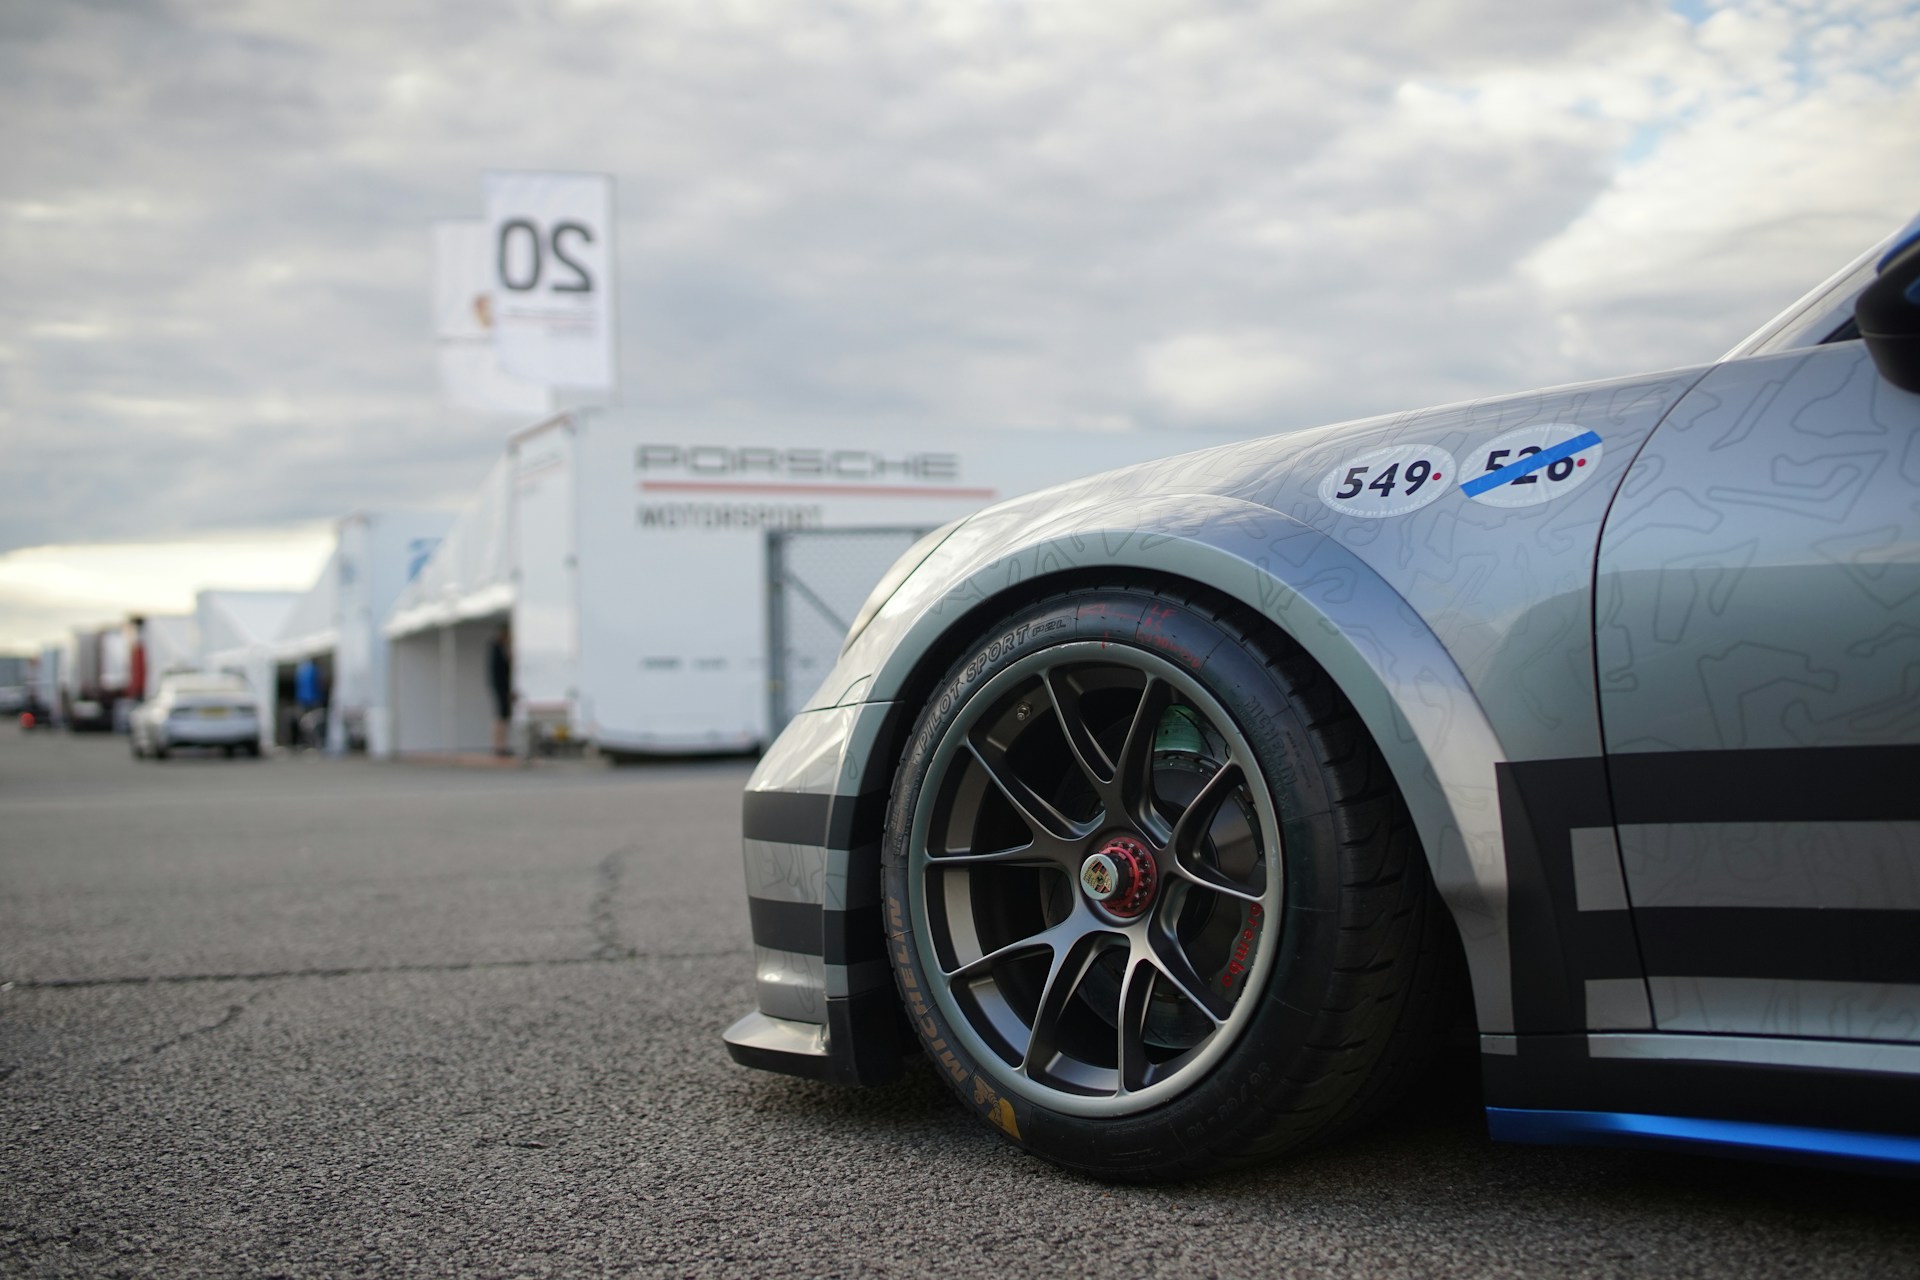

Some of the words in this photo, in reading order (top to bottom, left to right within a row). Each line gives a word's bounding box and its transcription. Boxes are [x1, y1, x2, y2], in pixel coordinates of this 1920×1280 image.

[635, 445, 960, 481] PORSCHE
[1336, 460, 1431, 499] 549
[1485, 446, 1574, 485] 526
[637, 502, 823, 531] MOTORSPORT
[919, 680, 964, 751] PILOT
[966, 624, 1030, 683] SPORT
[1031, 619, 1067, 637] P2L
[1243, 696, 1298, 786] MICHELIN
[888, 897, 969, 1084] MICHELIN
